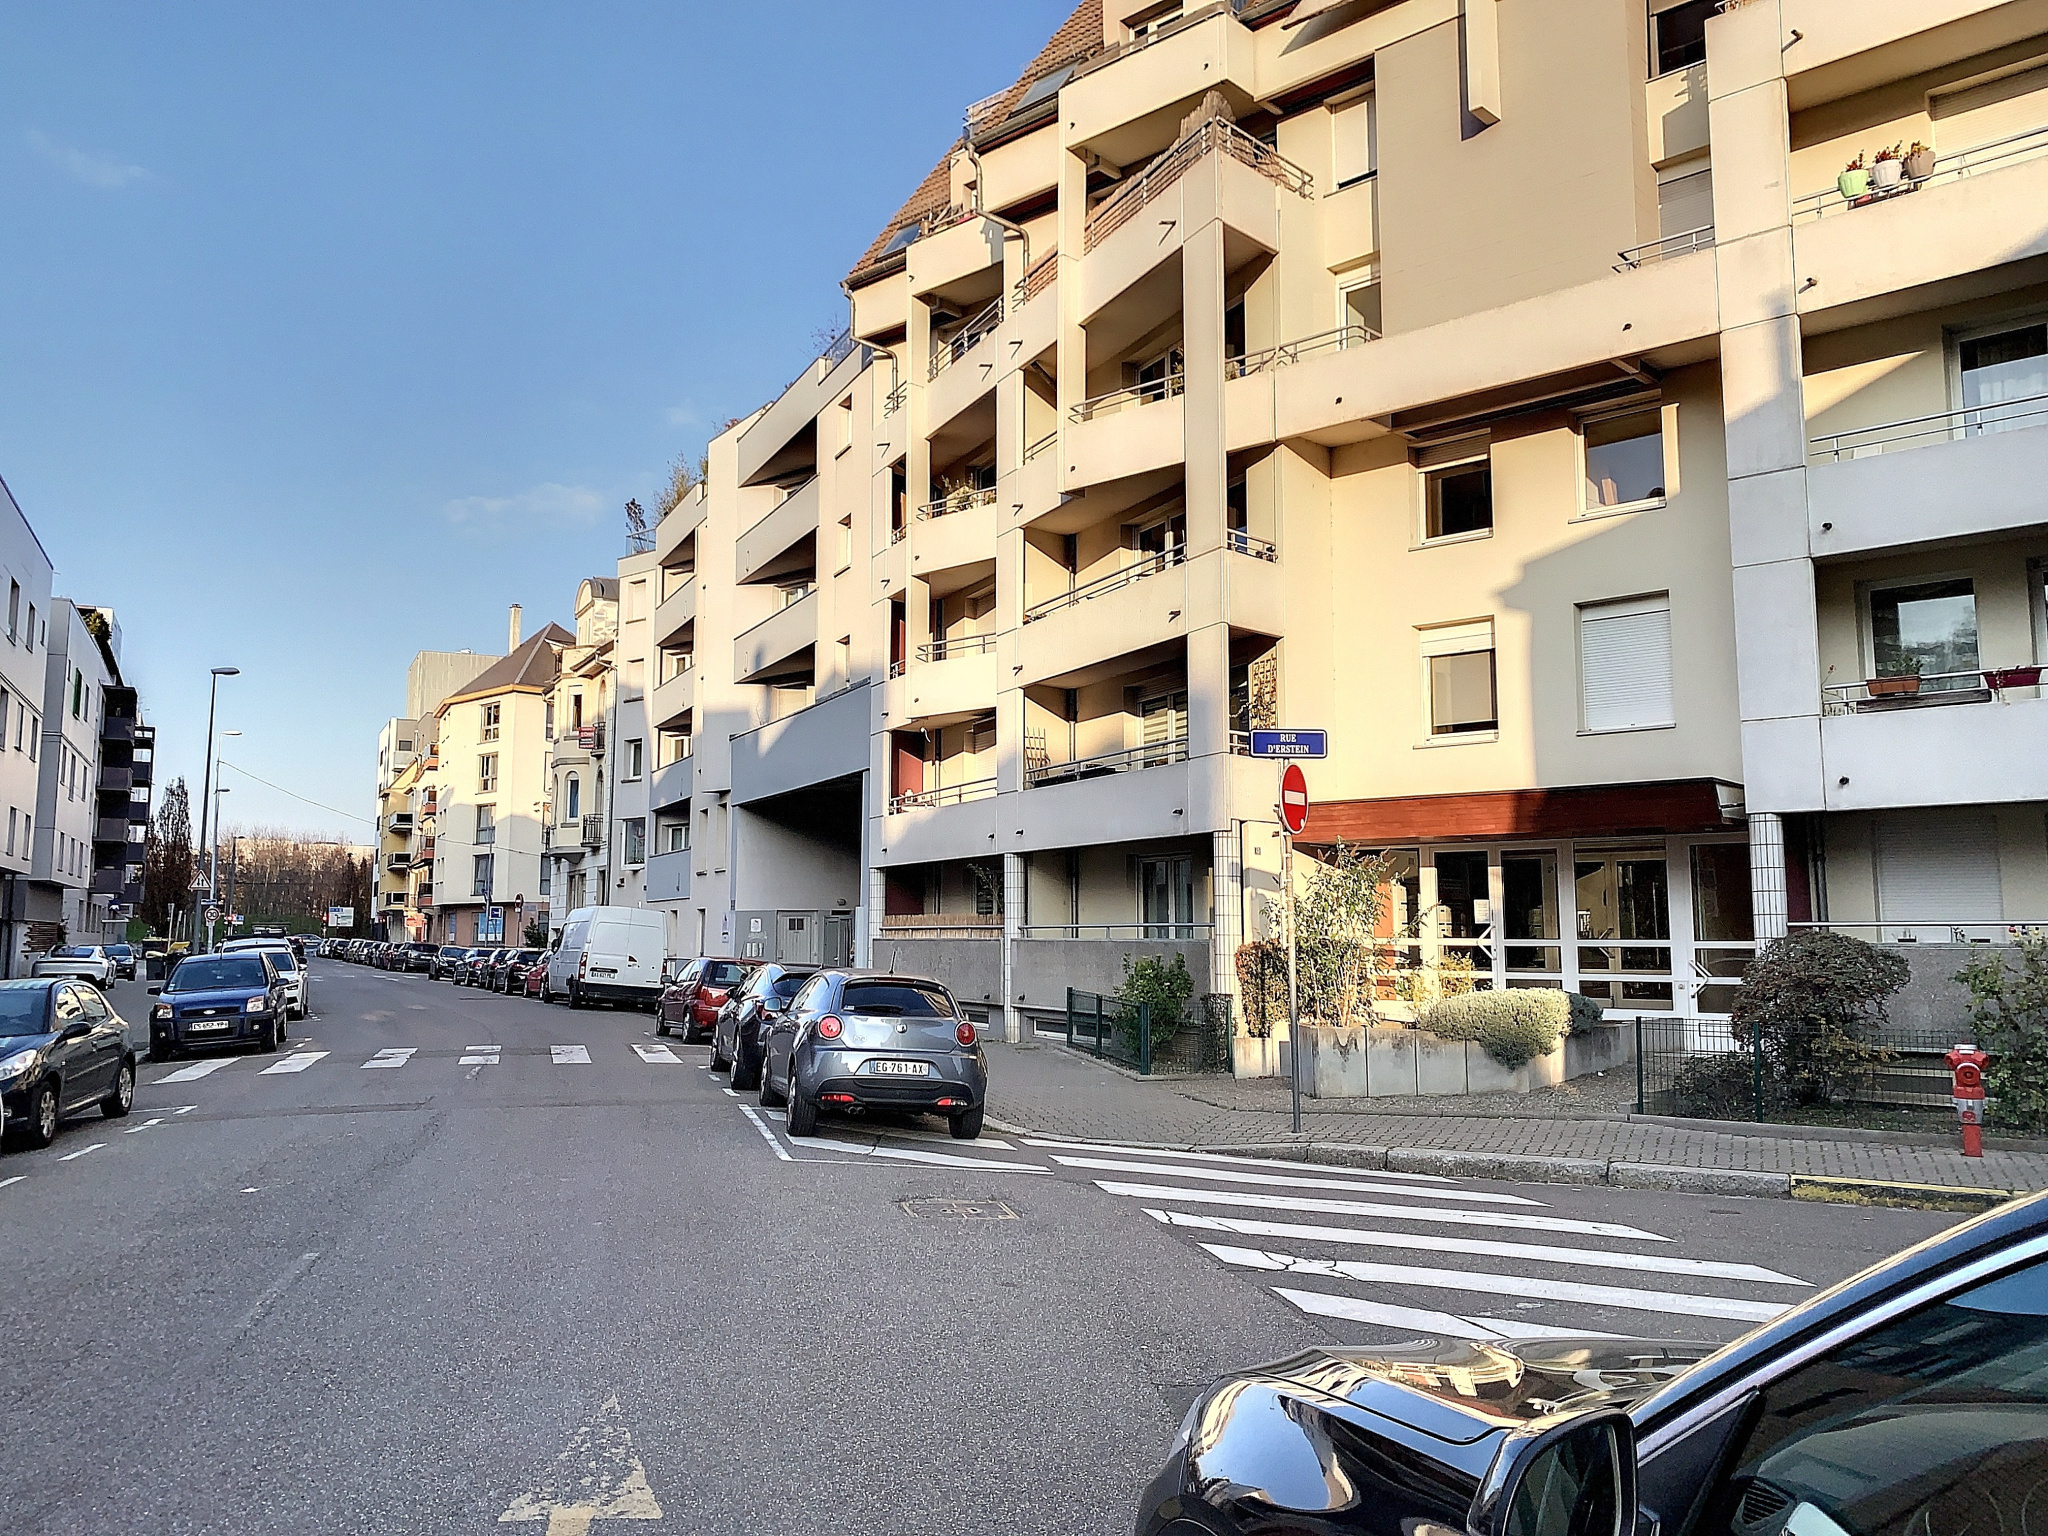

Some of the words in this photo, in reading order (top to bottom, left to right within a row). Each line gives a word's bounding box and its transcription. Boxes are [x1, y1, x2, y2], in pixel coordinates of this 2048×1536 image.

[1280, 734, 1297, 743] RUE
[1267, 744, 1310, 754] D'ERSTEIN
[875, 1061, 924, 1075] EG-761-AX
